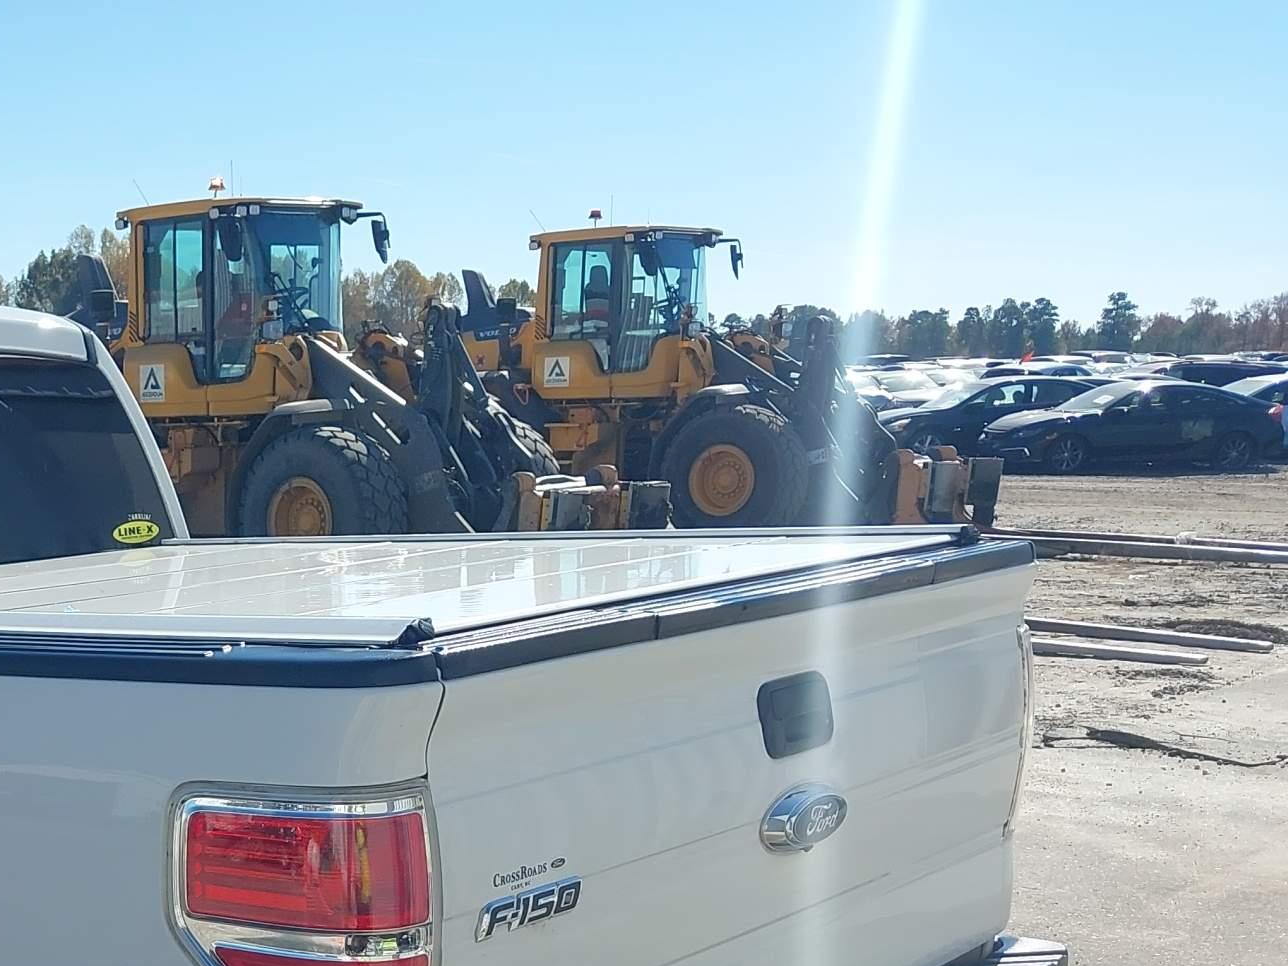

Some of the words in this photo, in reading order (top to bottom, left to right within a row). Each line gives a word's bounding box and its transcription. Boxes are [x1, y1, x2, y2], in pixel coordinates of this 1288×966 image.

[118, 525, 154, 536] LINE-X
[806, 802, 839, 836] Ford
[479, 878, 582, 939] F-150
